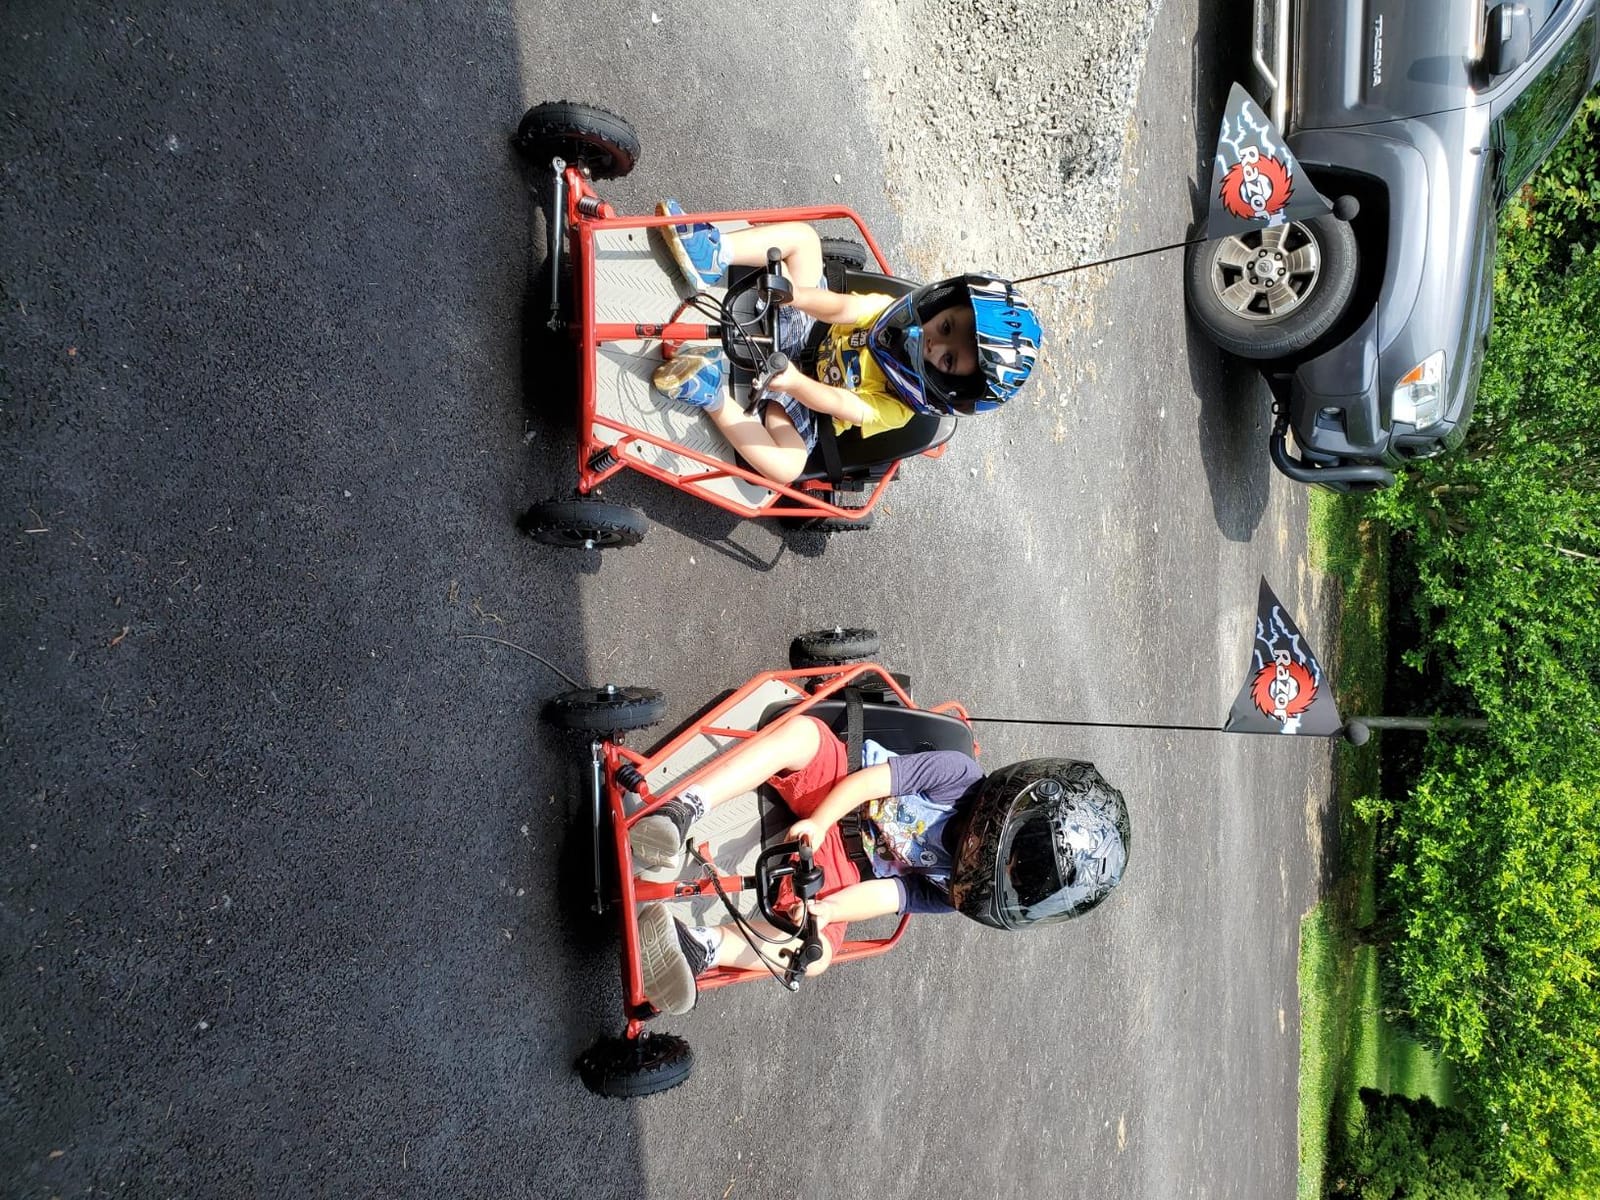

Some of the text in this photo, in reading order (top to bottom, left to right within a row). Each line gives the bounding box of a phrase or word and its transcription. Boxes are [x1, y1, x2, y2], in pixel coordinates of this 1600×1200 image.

[1372, 14, 1383, 88] TACOMA
[1239, 145, 1271, 221] Razor
[1273, 649, 1292, 724] Razor
